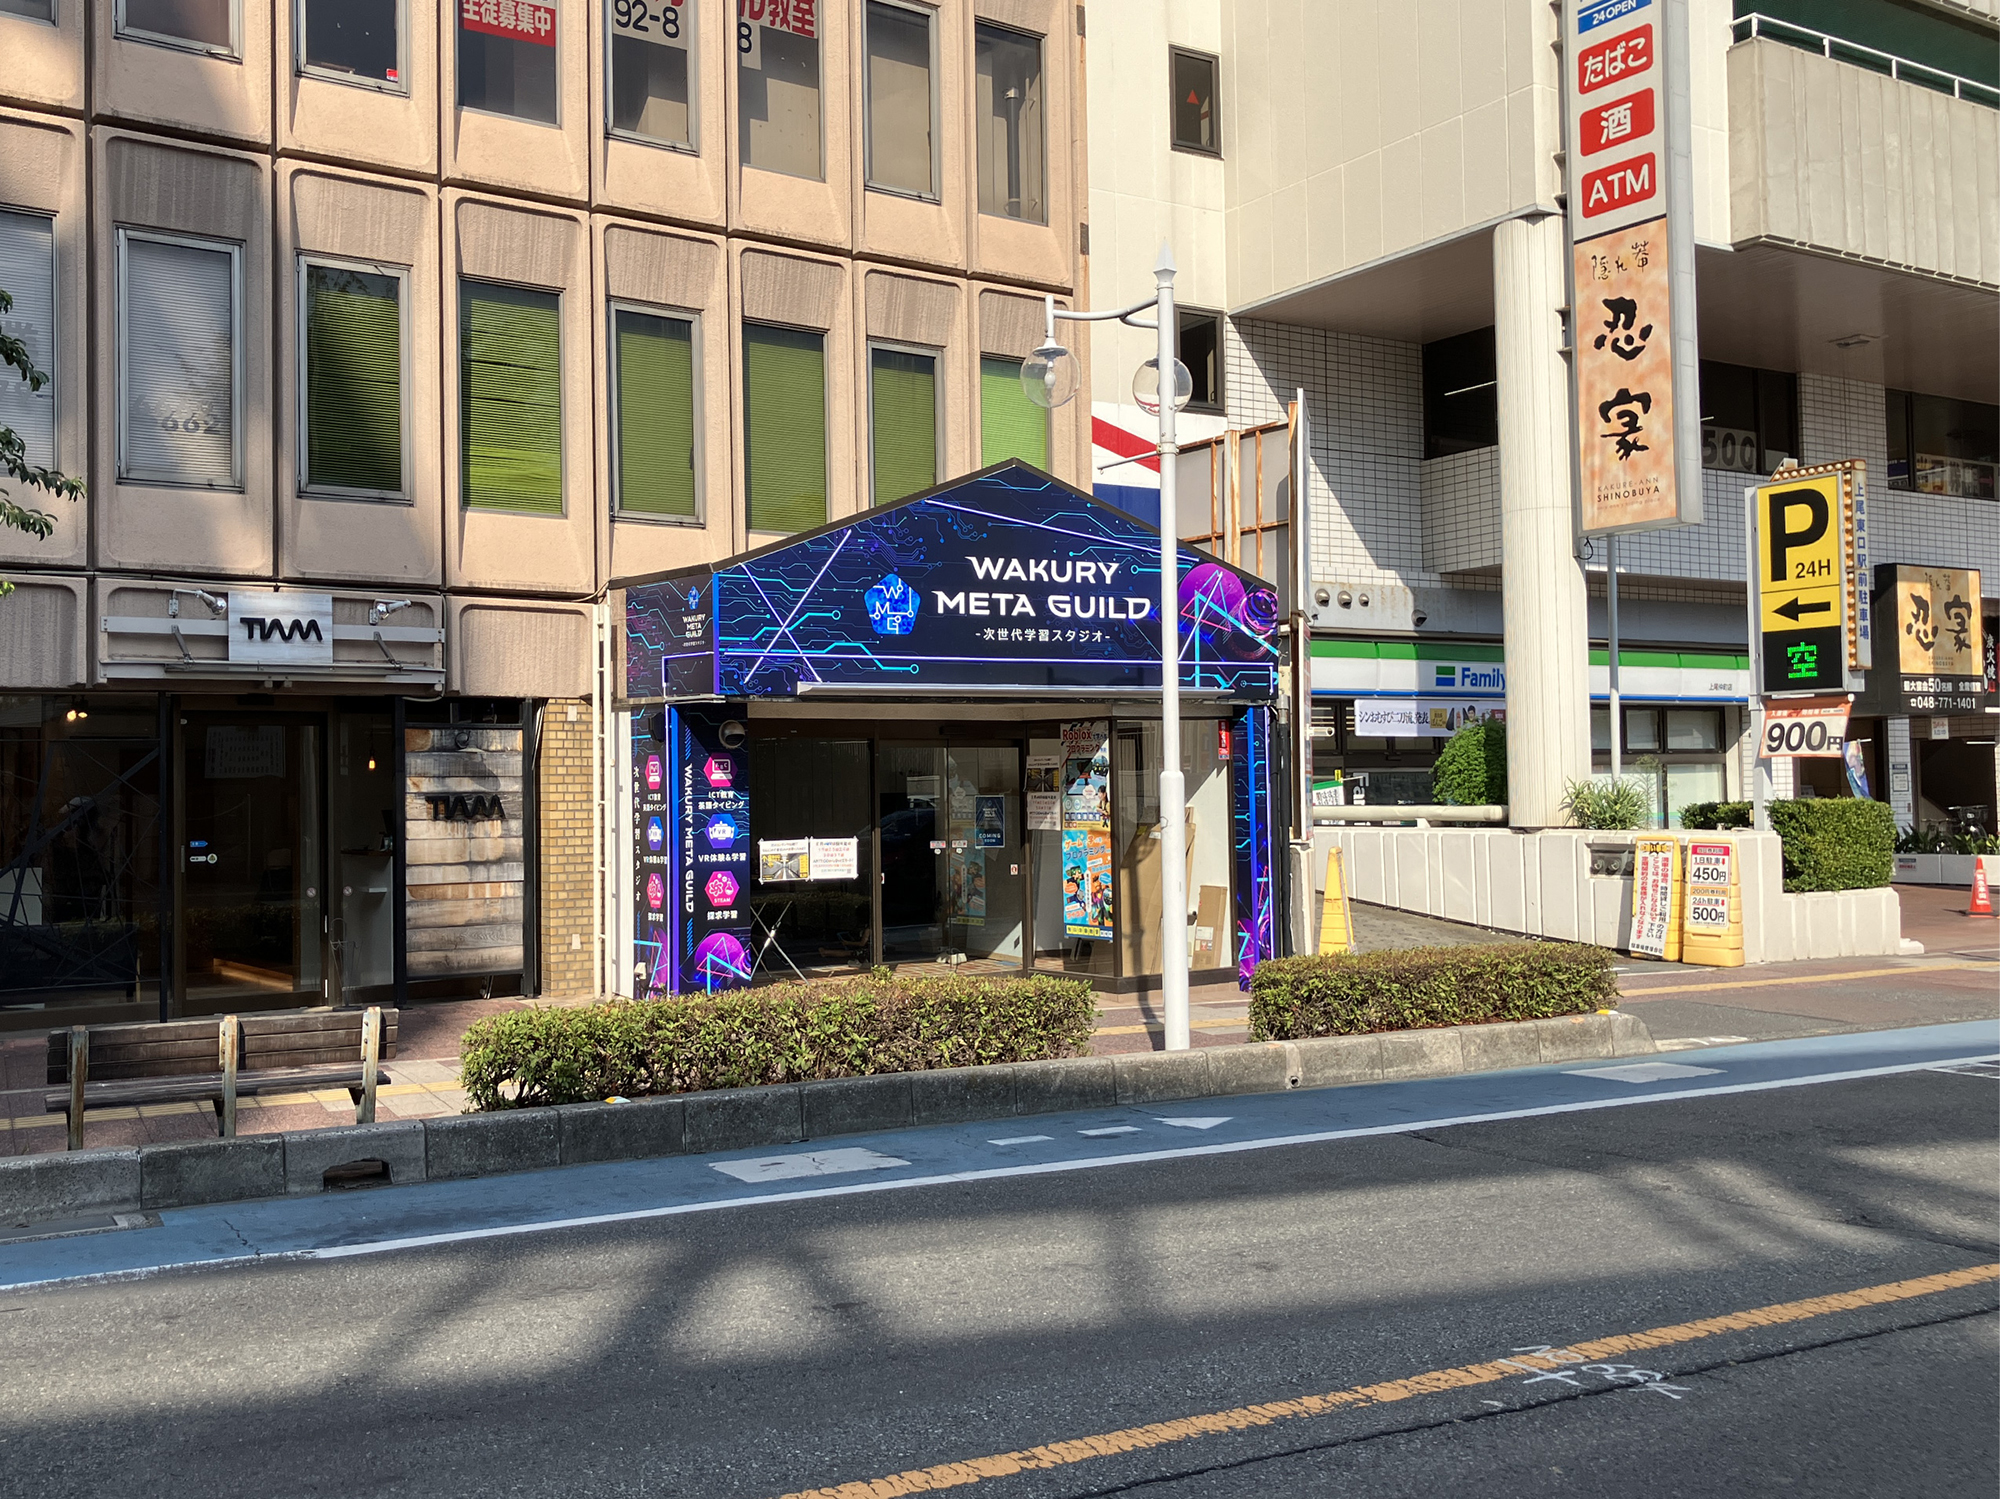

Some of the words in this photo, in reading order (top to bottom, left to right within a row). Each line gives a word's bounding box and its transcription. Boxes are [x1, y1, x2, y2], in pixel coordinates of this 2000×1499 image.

[463, 0, 551, 37] 生徒募集中
[1584, 37, 1647, 87] たばこ
[1600, 102, 1633, 144] 酒
[1588, 163, 1649, 208] ATM
[1593, 296, 1654, 461] 忍家
[1597, 485, 1660, 503] SHINOBUYA
[1769, 488, 1829, 582] P
[965, 556, 1119, 584] WAKURY
[1795, 558, 1831, 580] 24H
[1854, 482, 1870, 640] 上尾東口駅前駐車場
[682, 613, 706, 623] WAKURY
[932, 590, 1036, 616] META
[1048, 594, 1151, 619] GUILD
[240, 617, 323, 642] TIAM
[685, 630, 703, 639] GUILD
[686, 623, 702, 631] META
[1906, 593, 1972, 654] 忍家
[1787, 641, 1818, 679] 空
[1917, 696, 1976, 709] 048-771-1401
[1063, 728, 1091, 740] Roblox
[1767, 721, 1844, 752] 900円
[684, 763, 693, 823] WAKURY
[698, 801, 745, 810] 英語タイピング
[685, 826, 694, 866] META
[698, 852, 747, 862] VR体験&学習
[1693, 867, 1726, 881] 450円
[685, 870, 694, 913] GUILD
[1692, 907, 1725, 922] 500円
